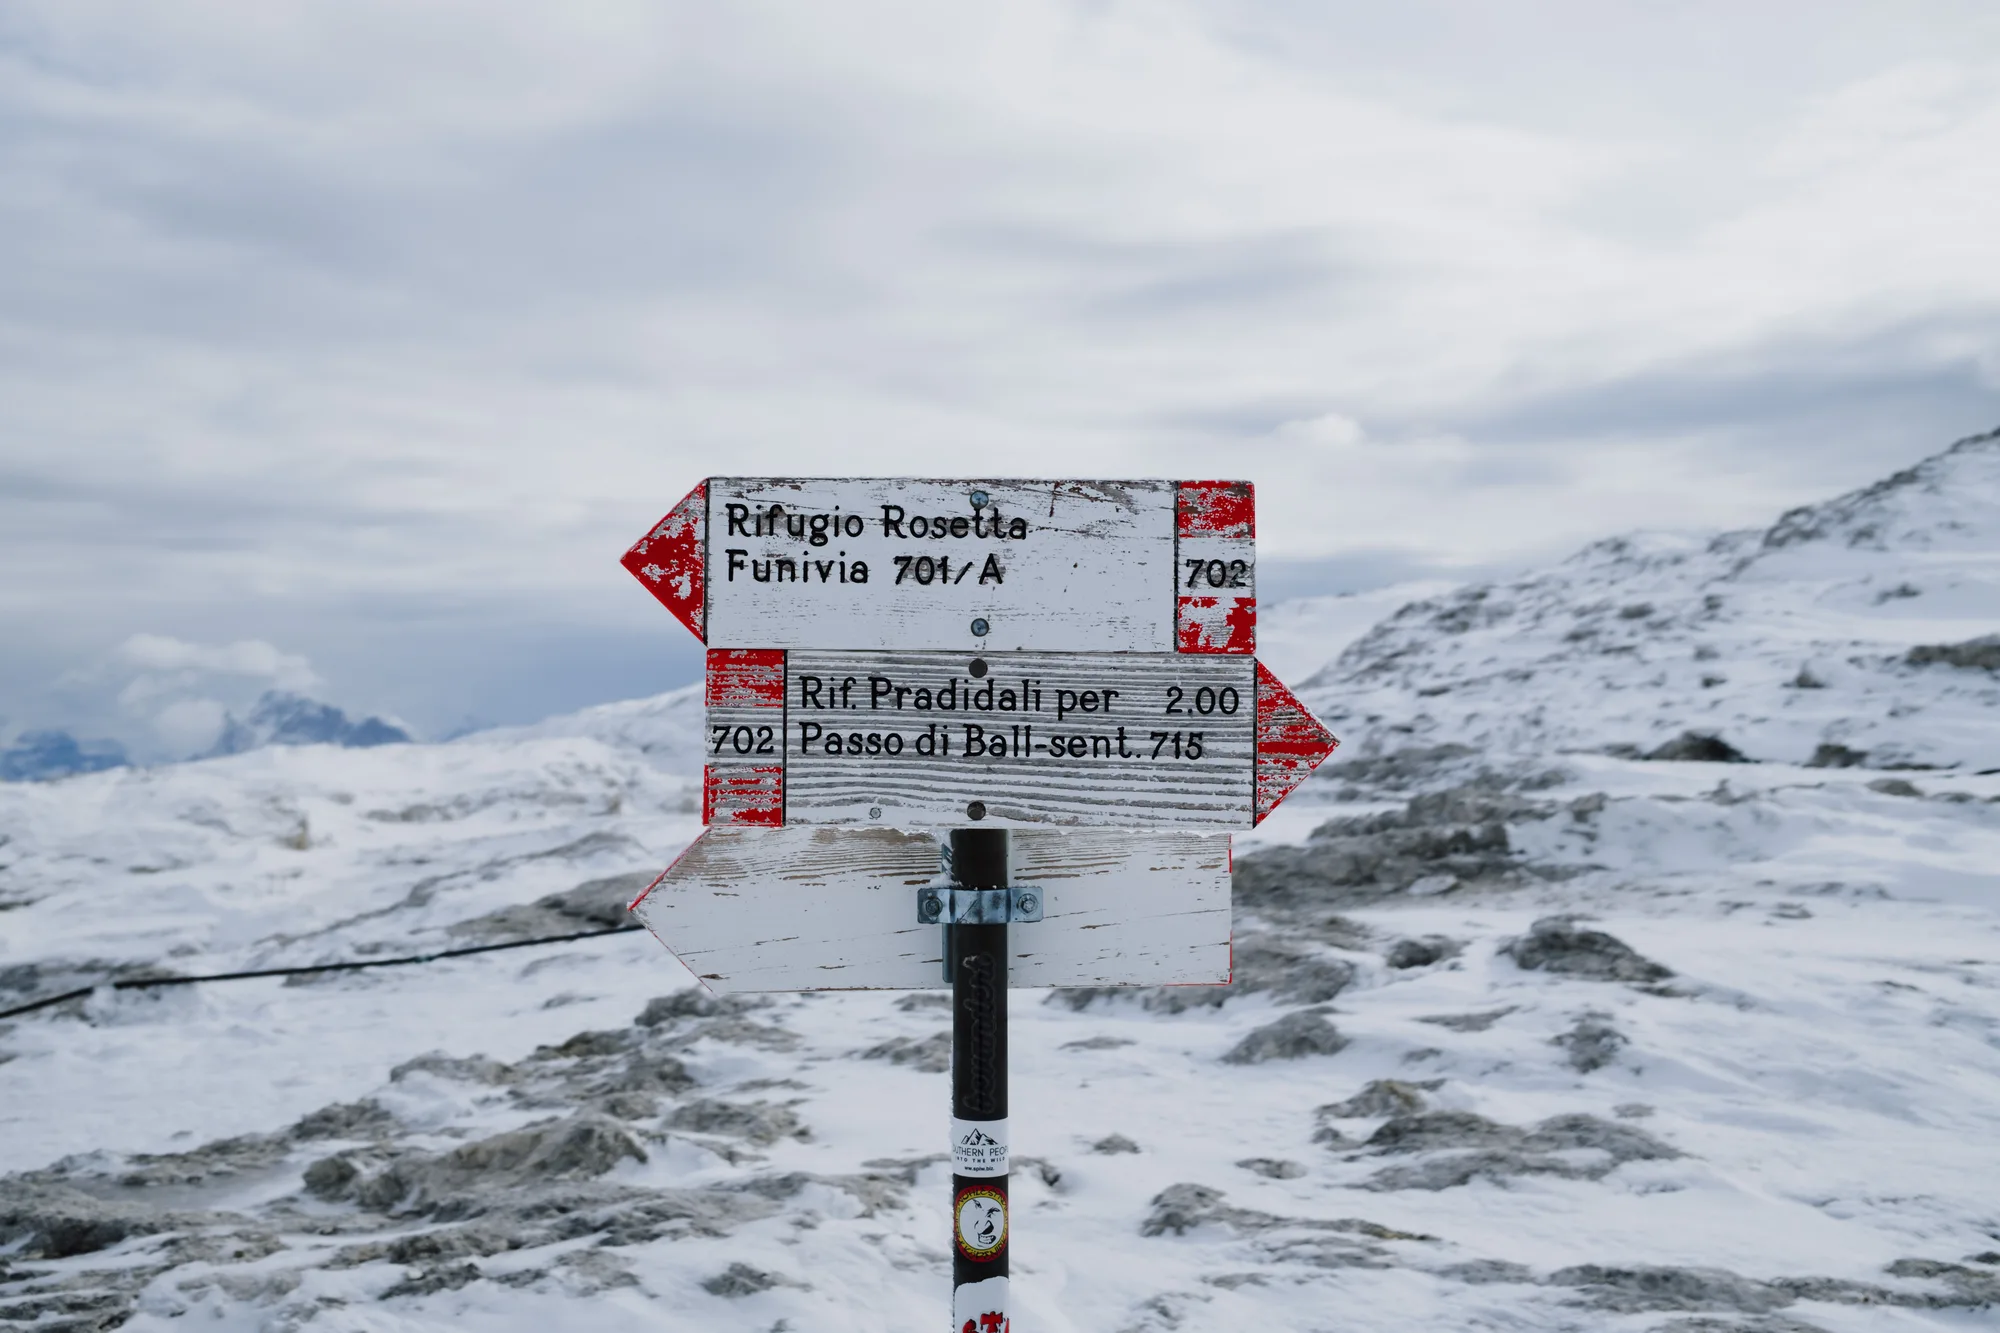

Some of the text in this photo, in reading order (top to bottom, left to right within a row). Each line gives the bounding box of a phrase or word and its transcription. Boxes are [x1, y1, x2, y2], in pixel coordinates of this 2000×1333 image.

[725, 502, 1027, 547] Rifugio Rosetta
[724, 548, 1004, 586] Funivia 701/A
[1185, 558, 1247, 588] 702
[798, 675, 1240, 722] Rif. Pradidali per 2.00
[712, 724, 775, 755] 702
[798, 721, 904, 756] Passo
[914, 723, 950, 757] di
